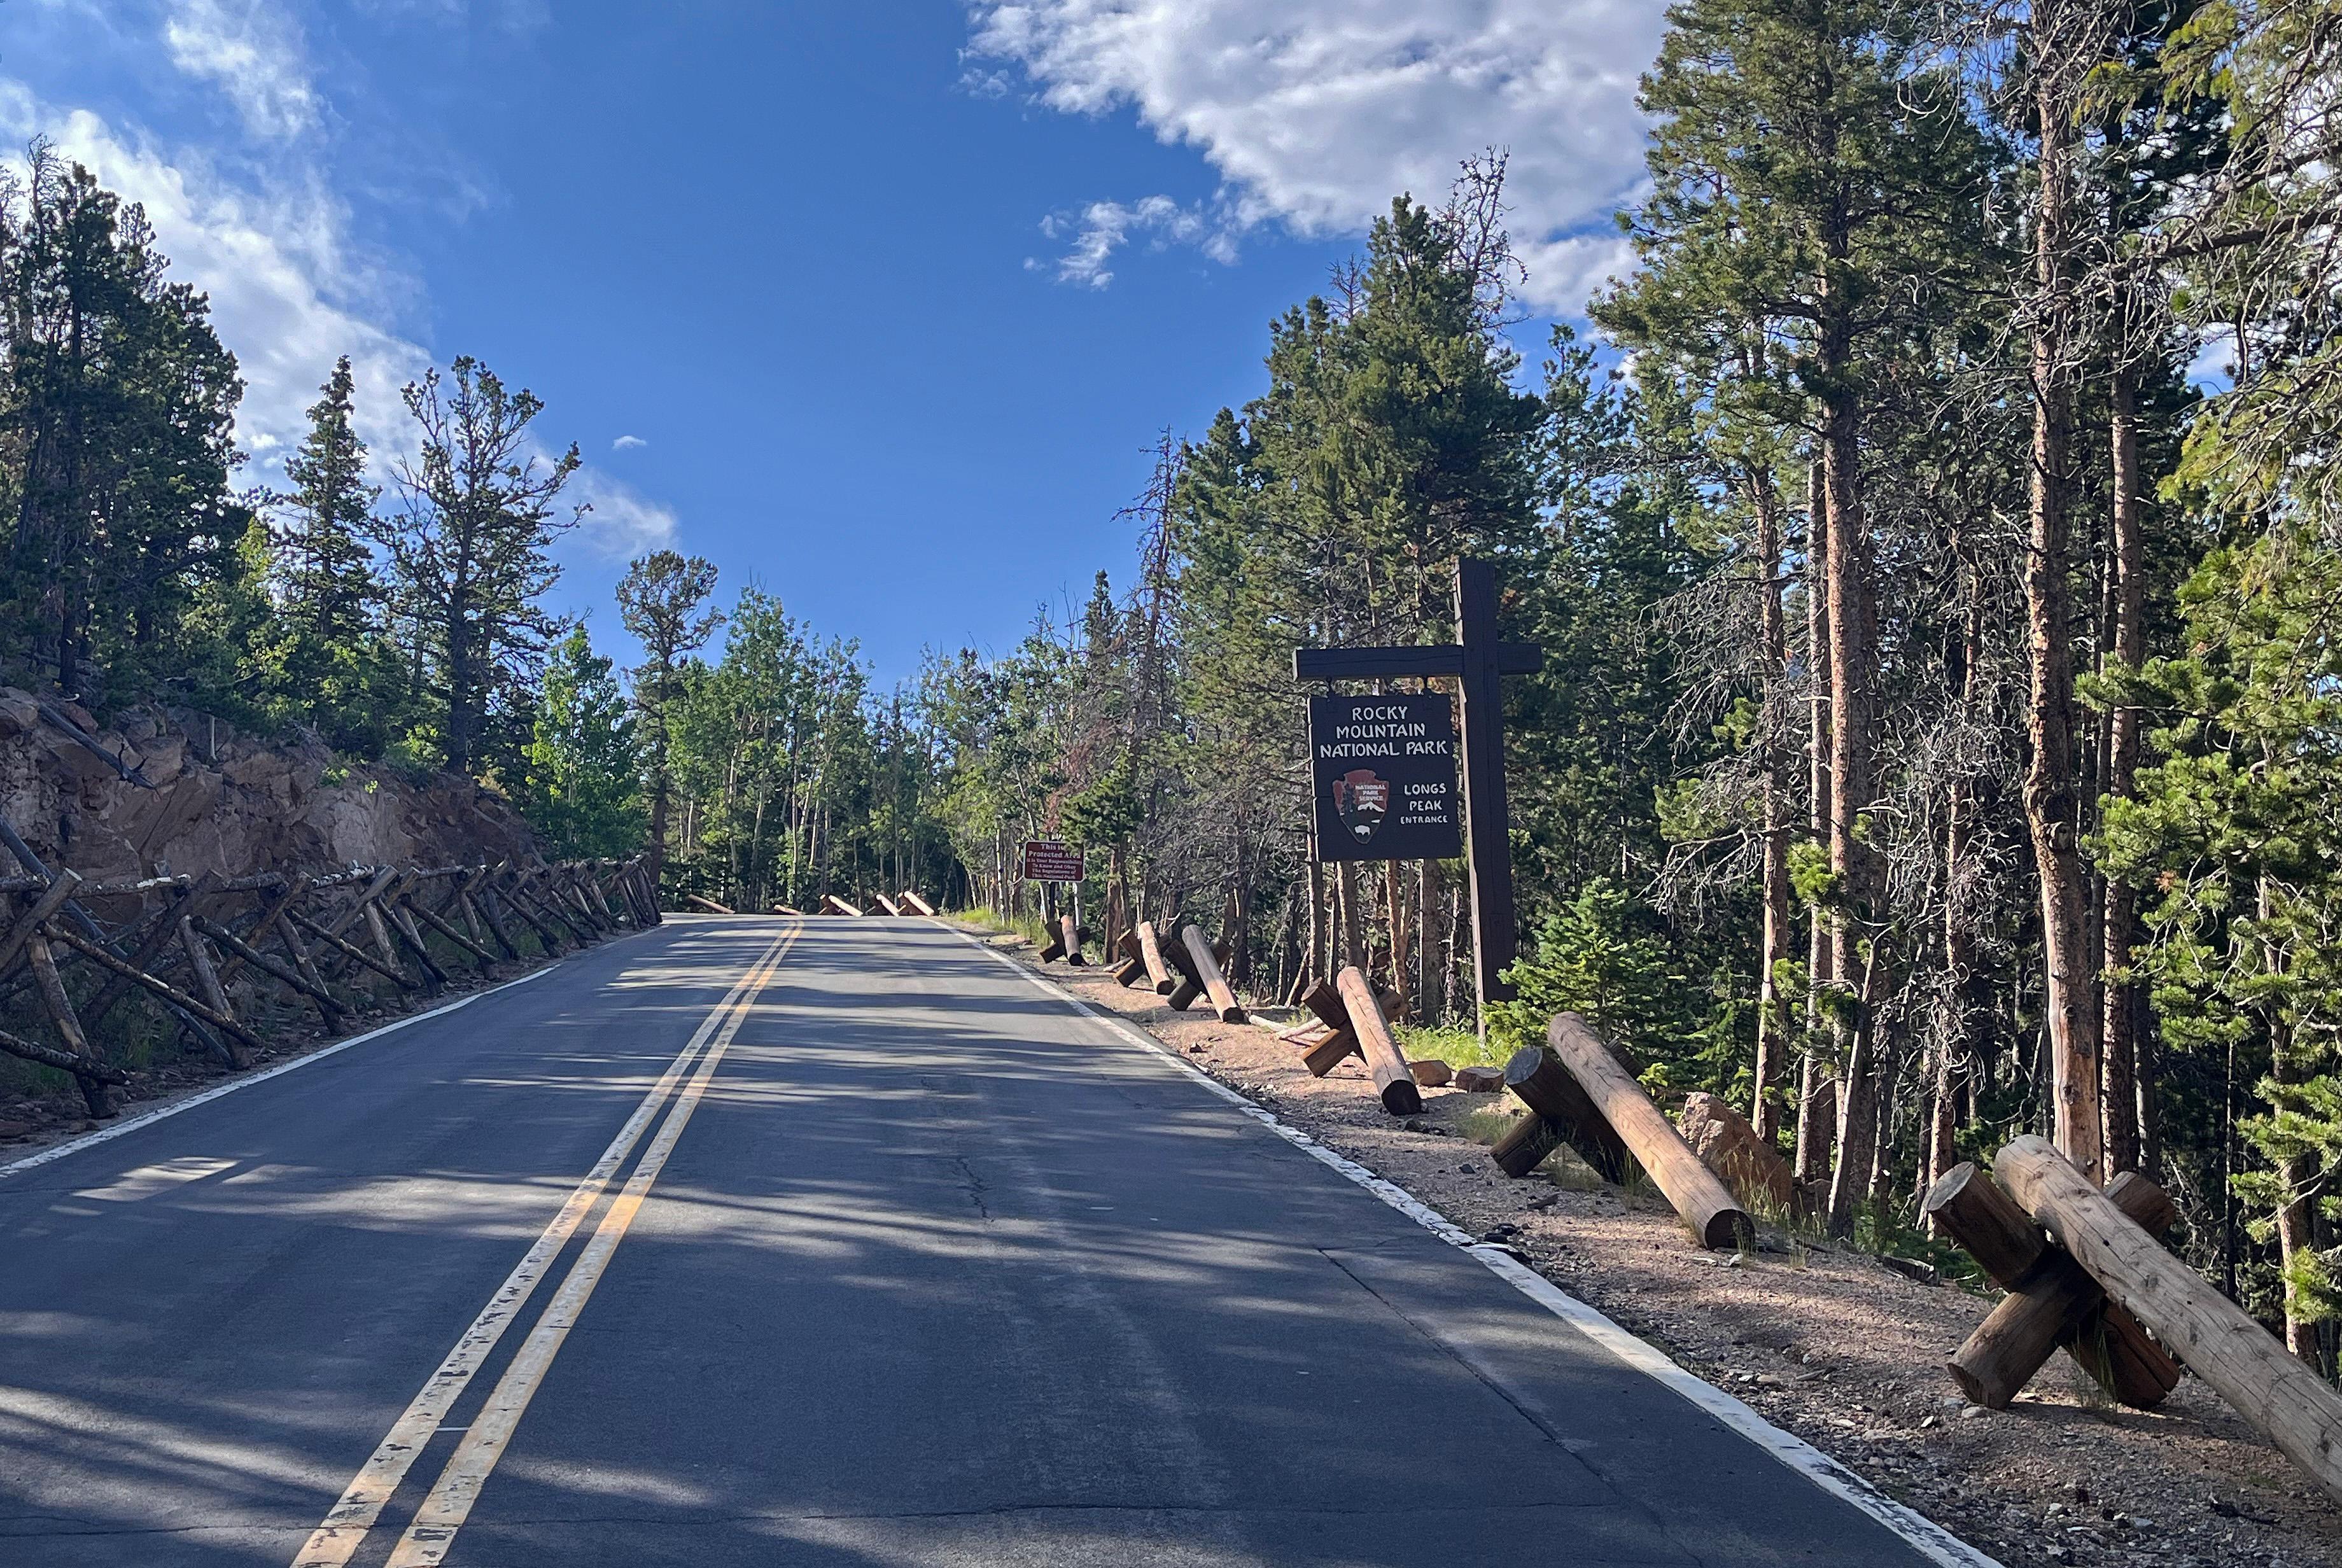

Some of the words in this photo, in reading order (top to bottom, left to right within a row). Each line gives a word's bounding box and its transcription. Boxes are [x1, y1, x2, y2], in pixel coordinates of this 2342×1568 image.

[1352, 706, 1408, 721] ROCKY
[1336, 723, 1426, 739] MOUNTAIN
[1320, 741, 1400, 758] NATIONAL
[1406, 740, 1448, 755] PARK
[1404, 783, 1447, 796] LONGS
[1409, 800, 1443, 811] PEAK
[1400, 815, 1448, 825] ENTRANCE
